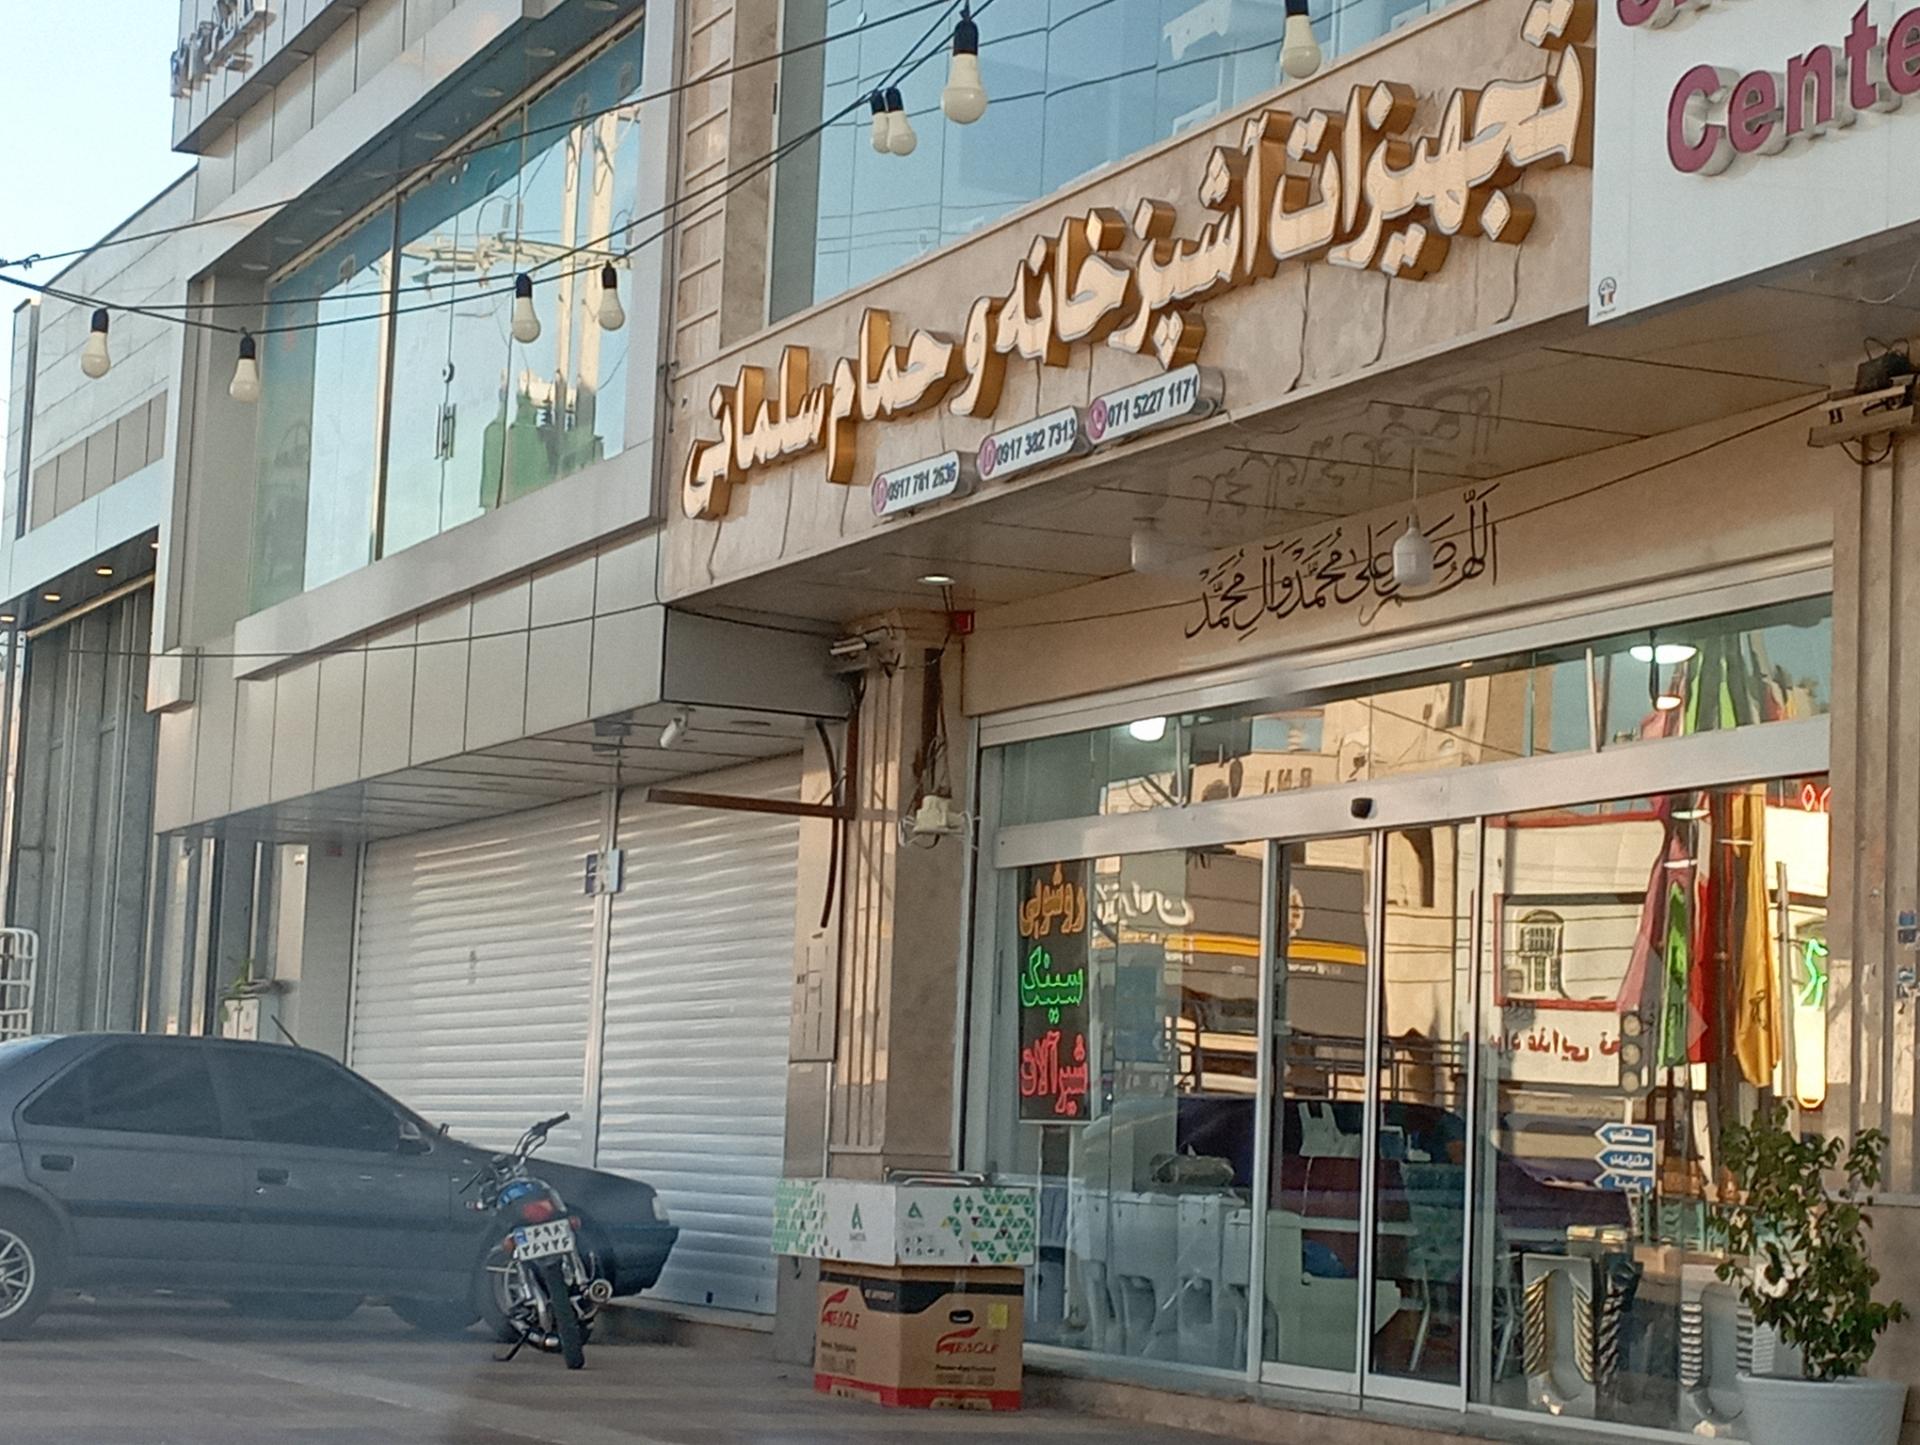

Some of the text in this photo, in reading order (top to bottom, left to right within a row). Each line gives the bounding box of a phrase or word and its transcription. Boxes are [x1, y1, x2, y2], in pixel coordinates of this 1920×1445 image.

[1270, 0, 1584, 277] تجهیزات
[825, 308, 954, 484] حمام
[951, 296, 995, 417] و
[1107, 374, 1199, 428] 071 5227 1171
[682, 344, 827, 520] سلمانی
[887, 475, 912, 502] 0917
